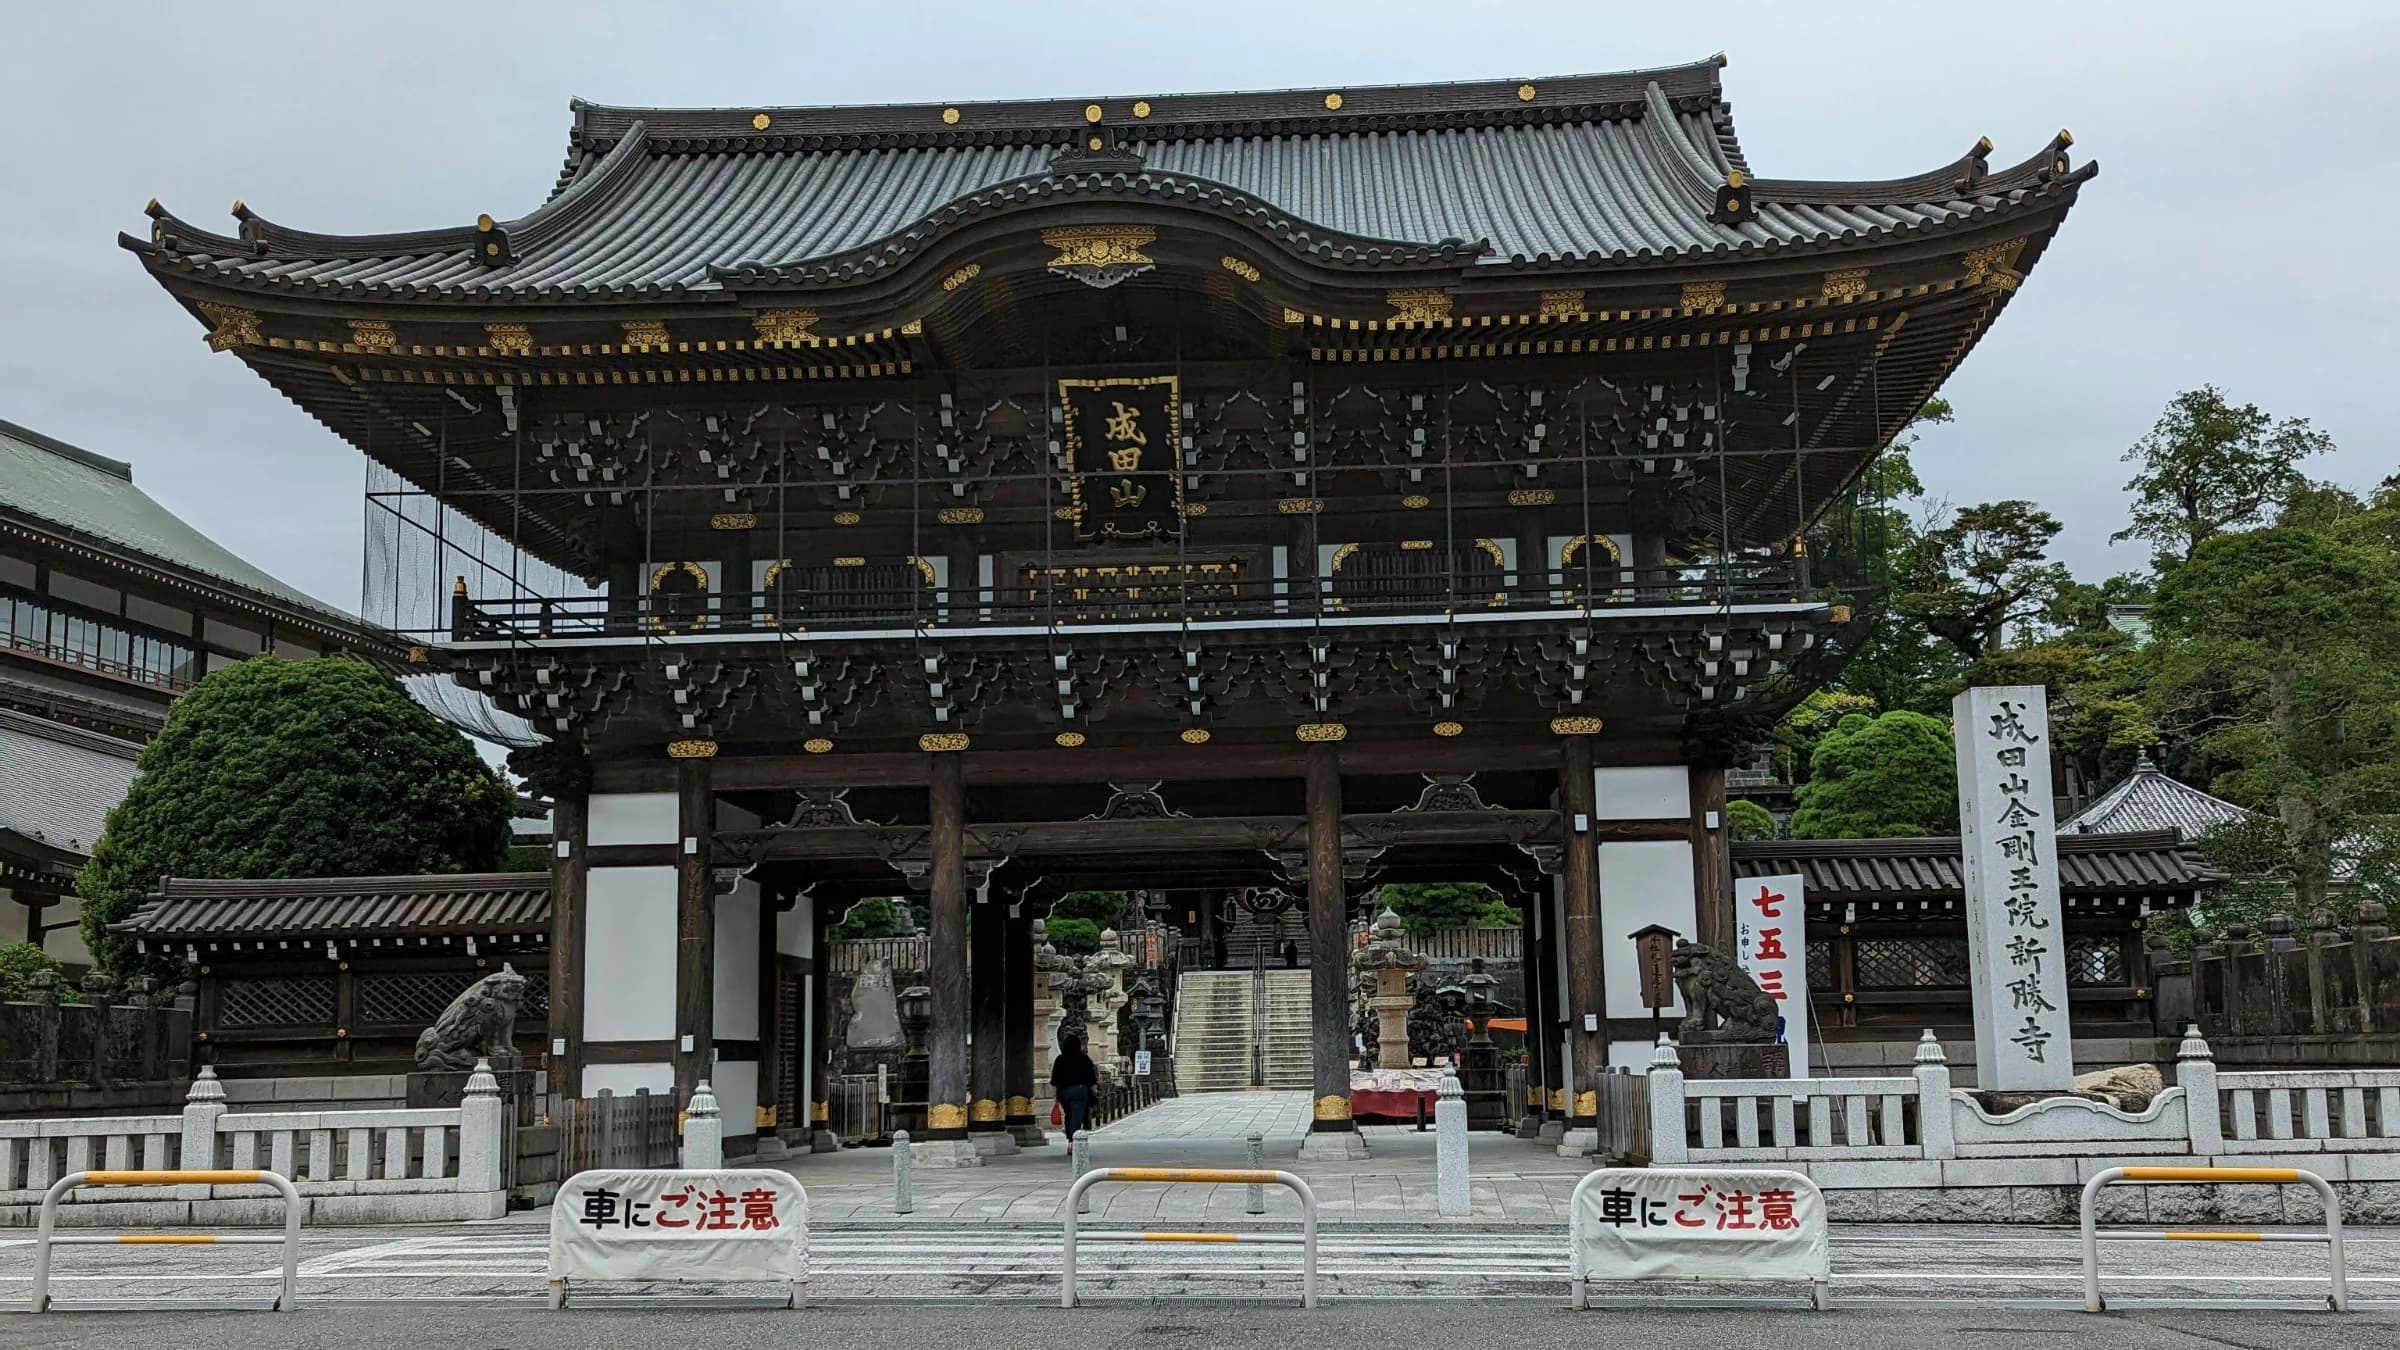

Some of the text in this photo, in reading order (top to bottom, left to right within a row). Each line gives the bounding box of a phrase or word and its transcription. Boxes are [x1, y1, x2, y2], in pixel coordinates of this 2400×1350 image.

[1105, 401, 1146, 507] 成田山
[1988, 701, 2056, 1063] 成田山金剛王院新勝寺
[1752, 885, 1788, 1000] 七五三
[580, 1185, 779, 1231] 車にご注意
[1599, 1184, 1799, 1230] 車にご注意
